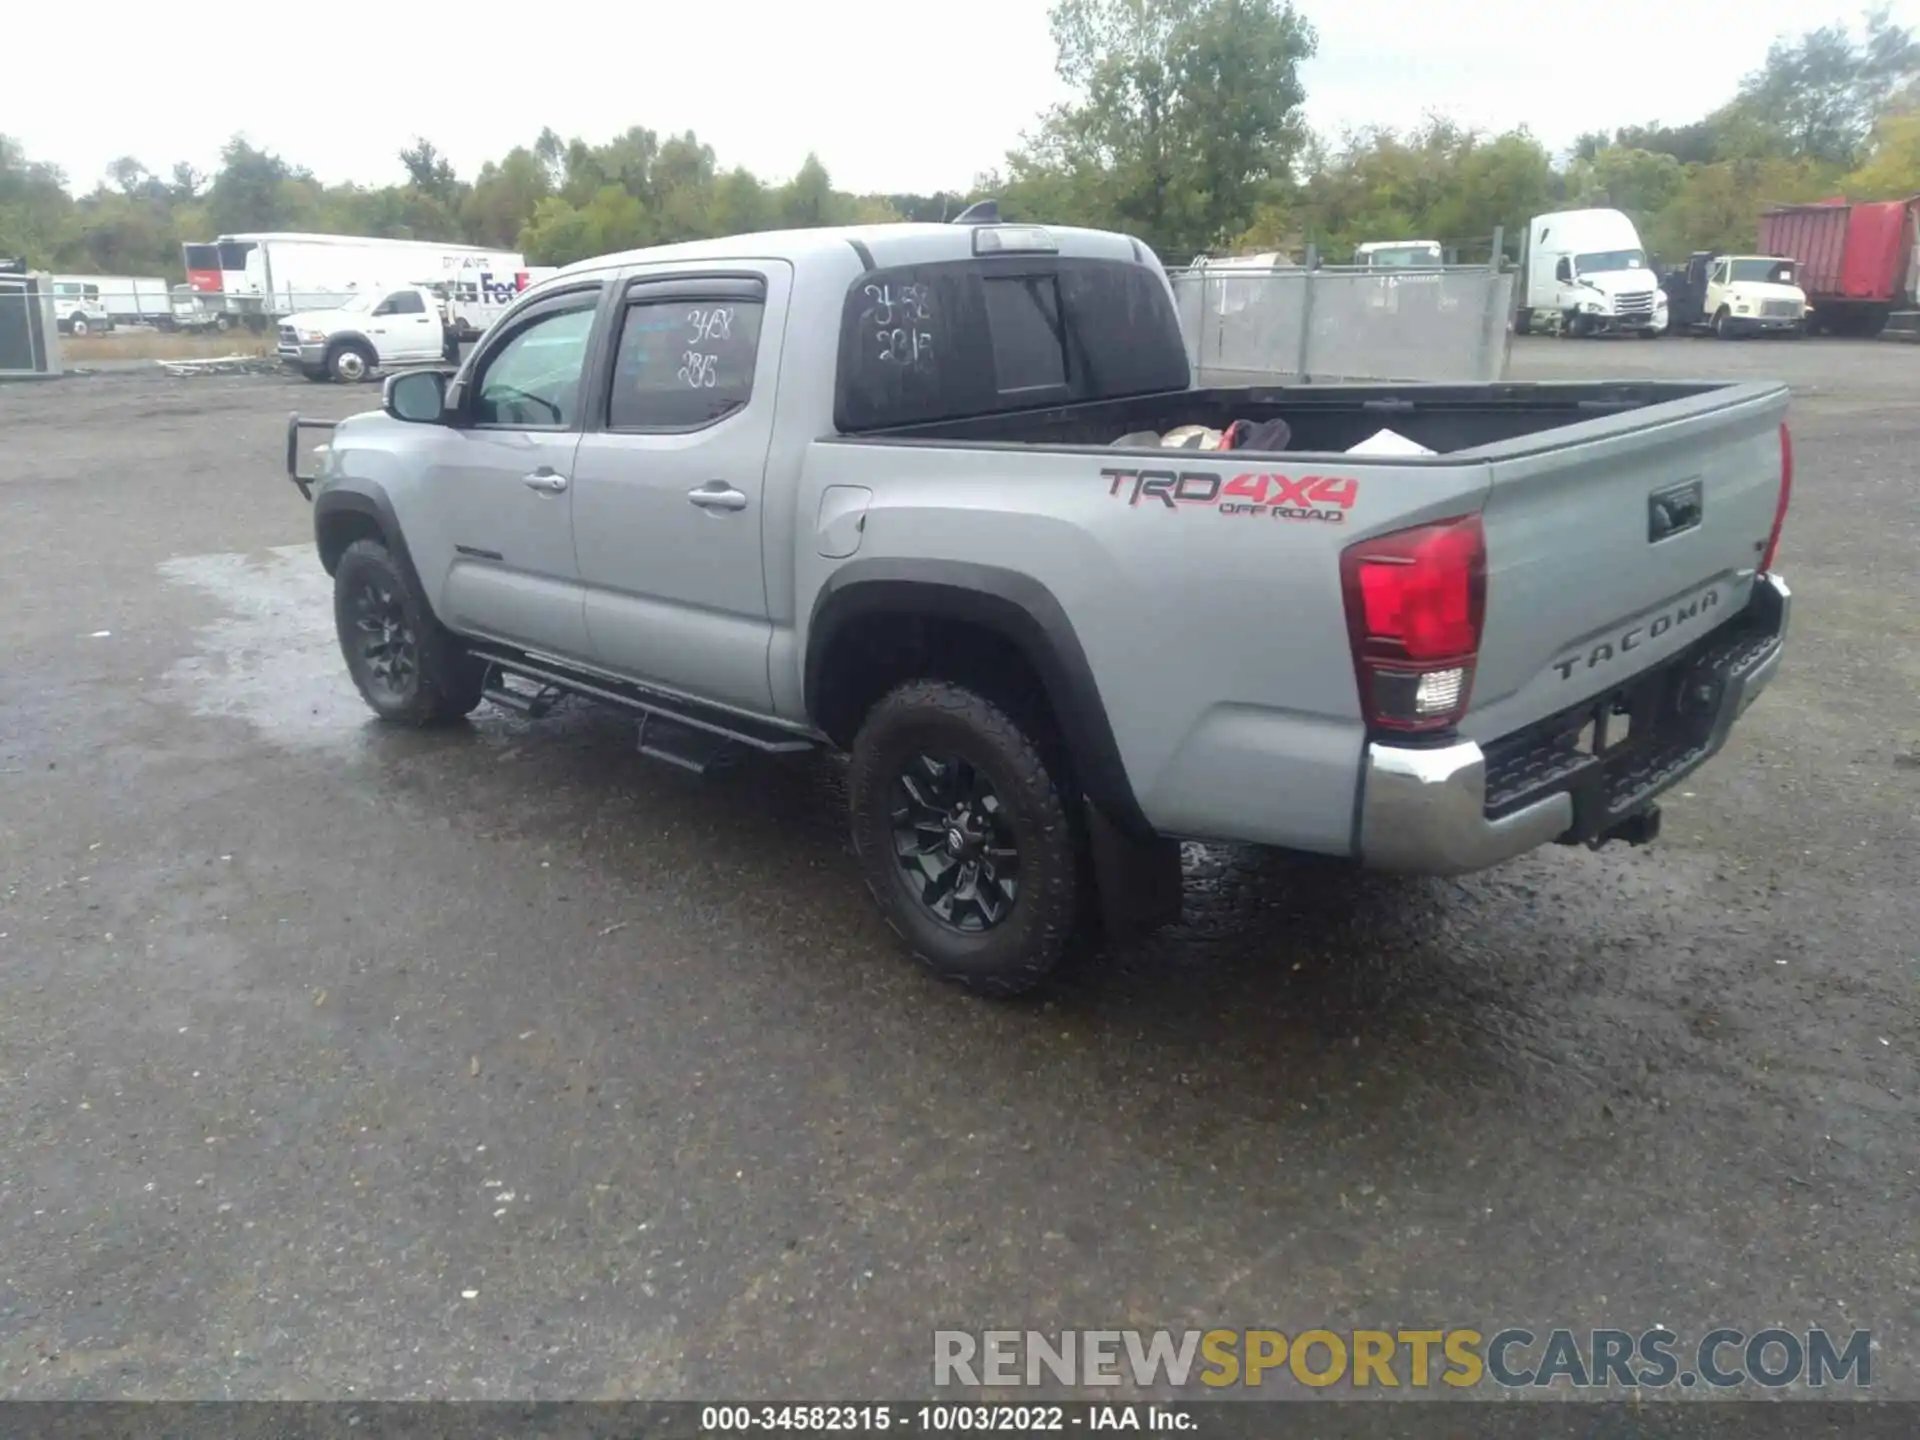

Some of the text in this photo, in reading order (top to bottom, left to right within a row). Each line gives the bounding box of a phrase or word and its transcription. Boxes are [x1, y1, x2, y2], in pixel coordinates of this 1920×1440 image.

[480, 273, 531, 304] FedE
[1100, 468, 1222, 509] TRD
[1219, 503, 1346, 523] OFF ROAD
[1553, 591, 1718, 680] TACOMA
